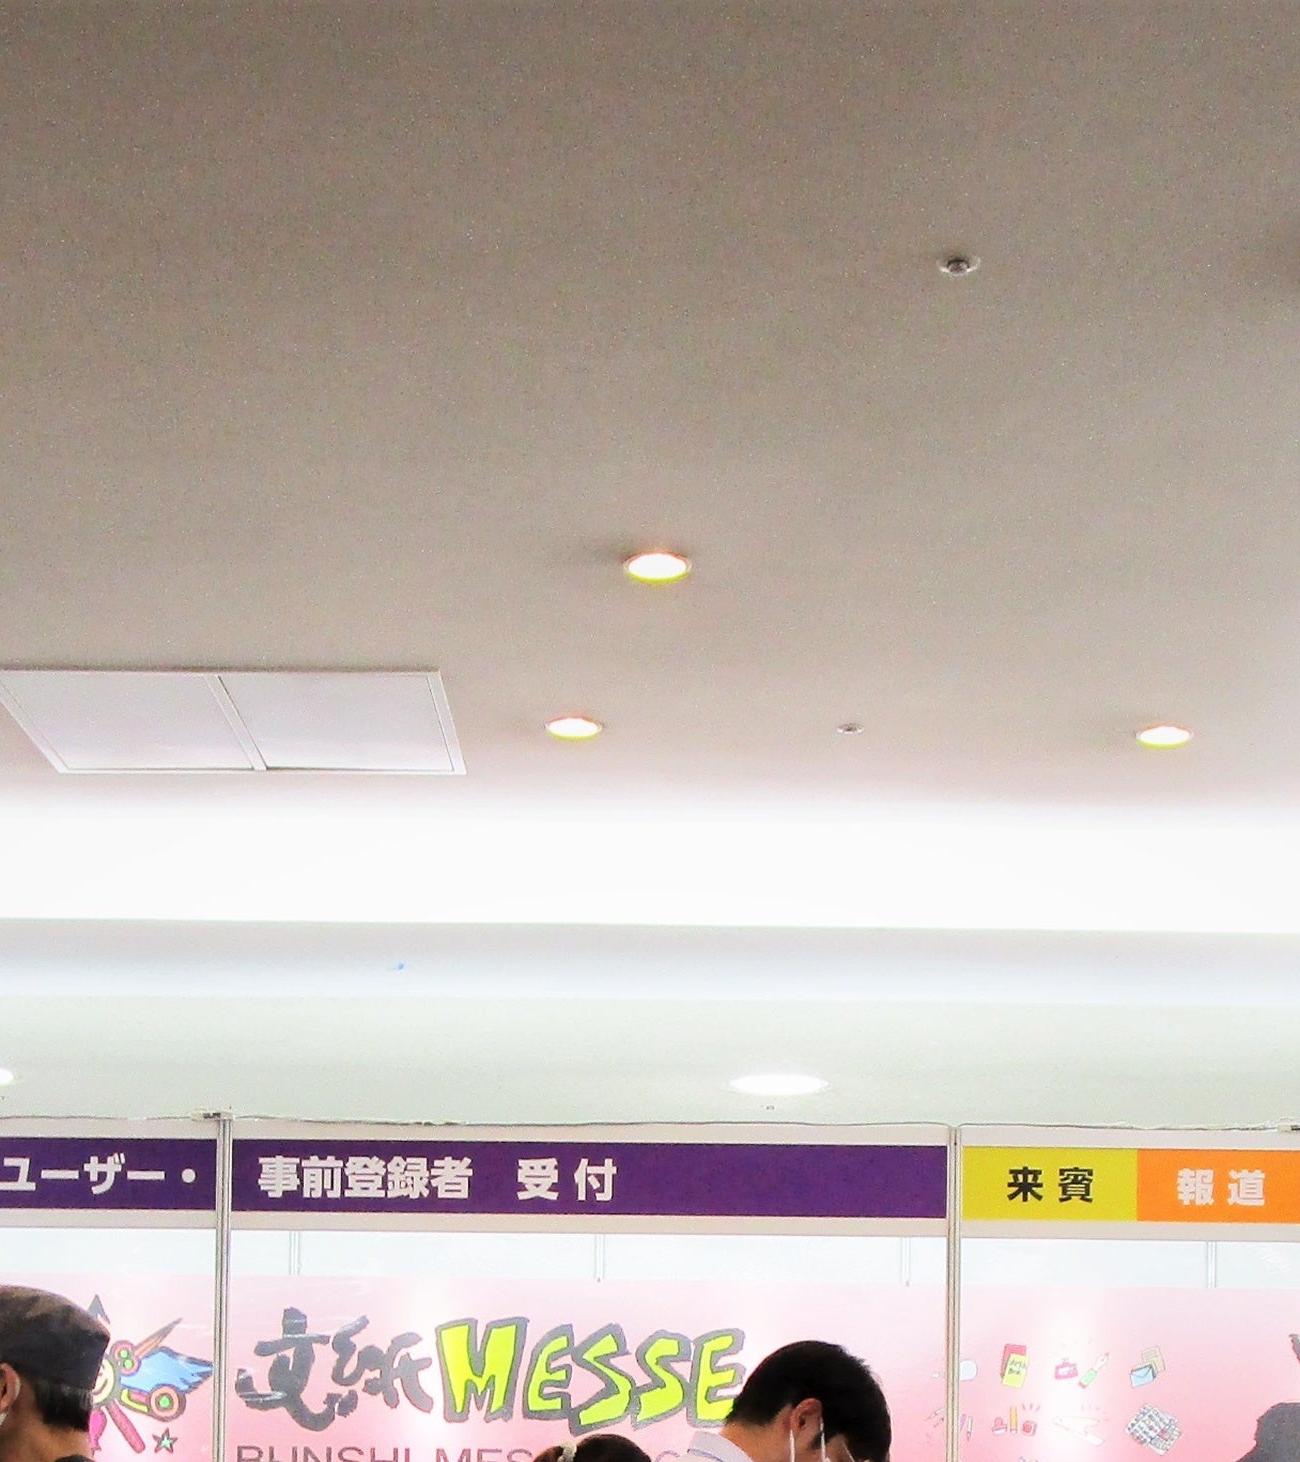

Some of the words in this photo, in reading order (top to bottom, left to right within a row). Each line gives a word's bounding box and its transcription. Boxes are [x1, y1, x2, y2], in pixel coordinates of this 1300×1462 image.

[257, 1156, 474, 1199] 事前登録者
[516, 1157, 618, 1202] 受付
[1006, 1166, 1094, 1203] 来賓
[1176, 1168, 1266, 1207] 報道
